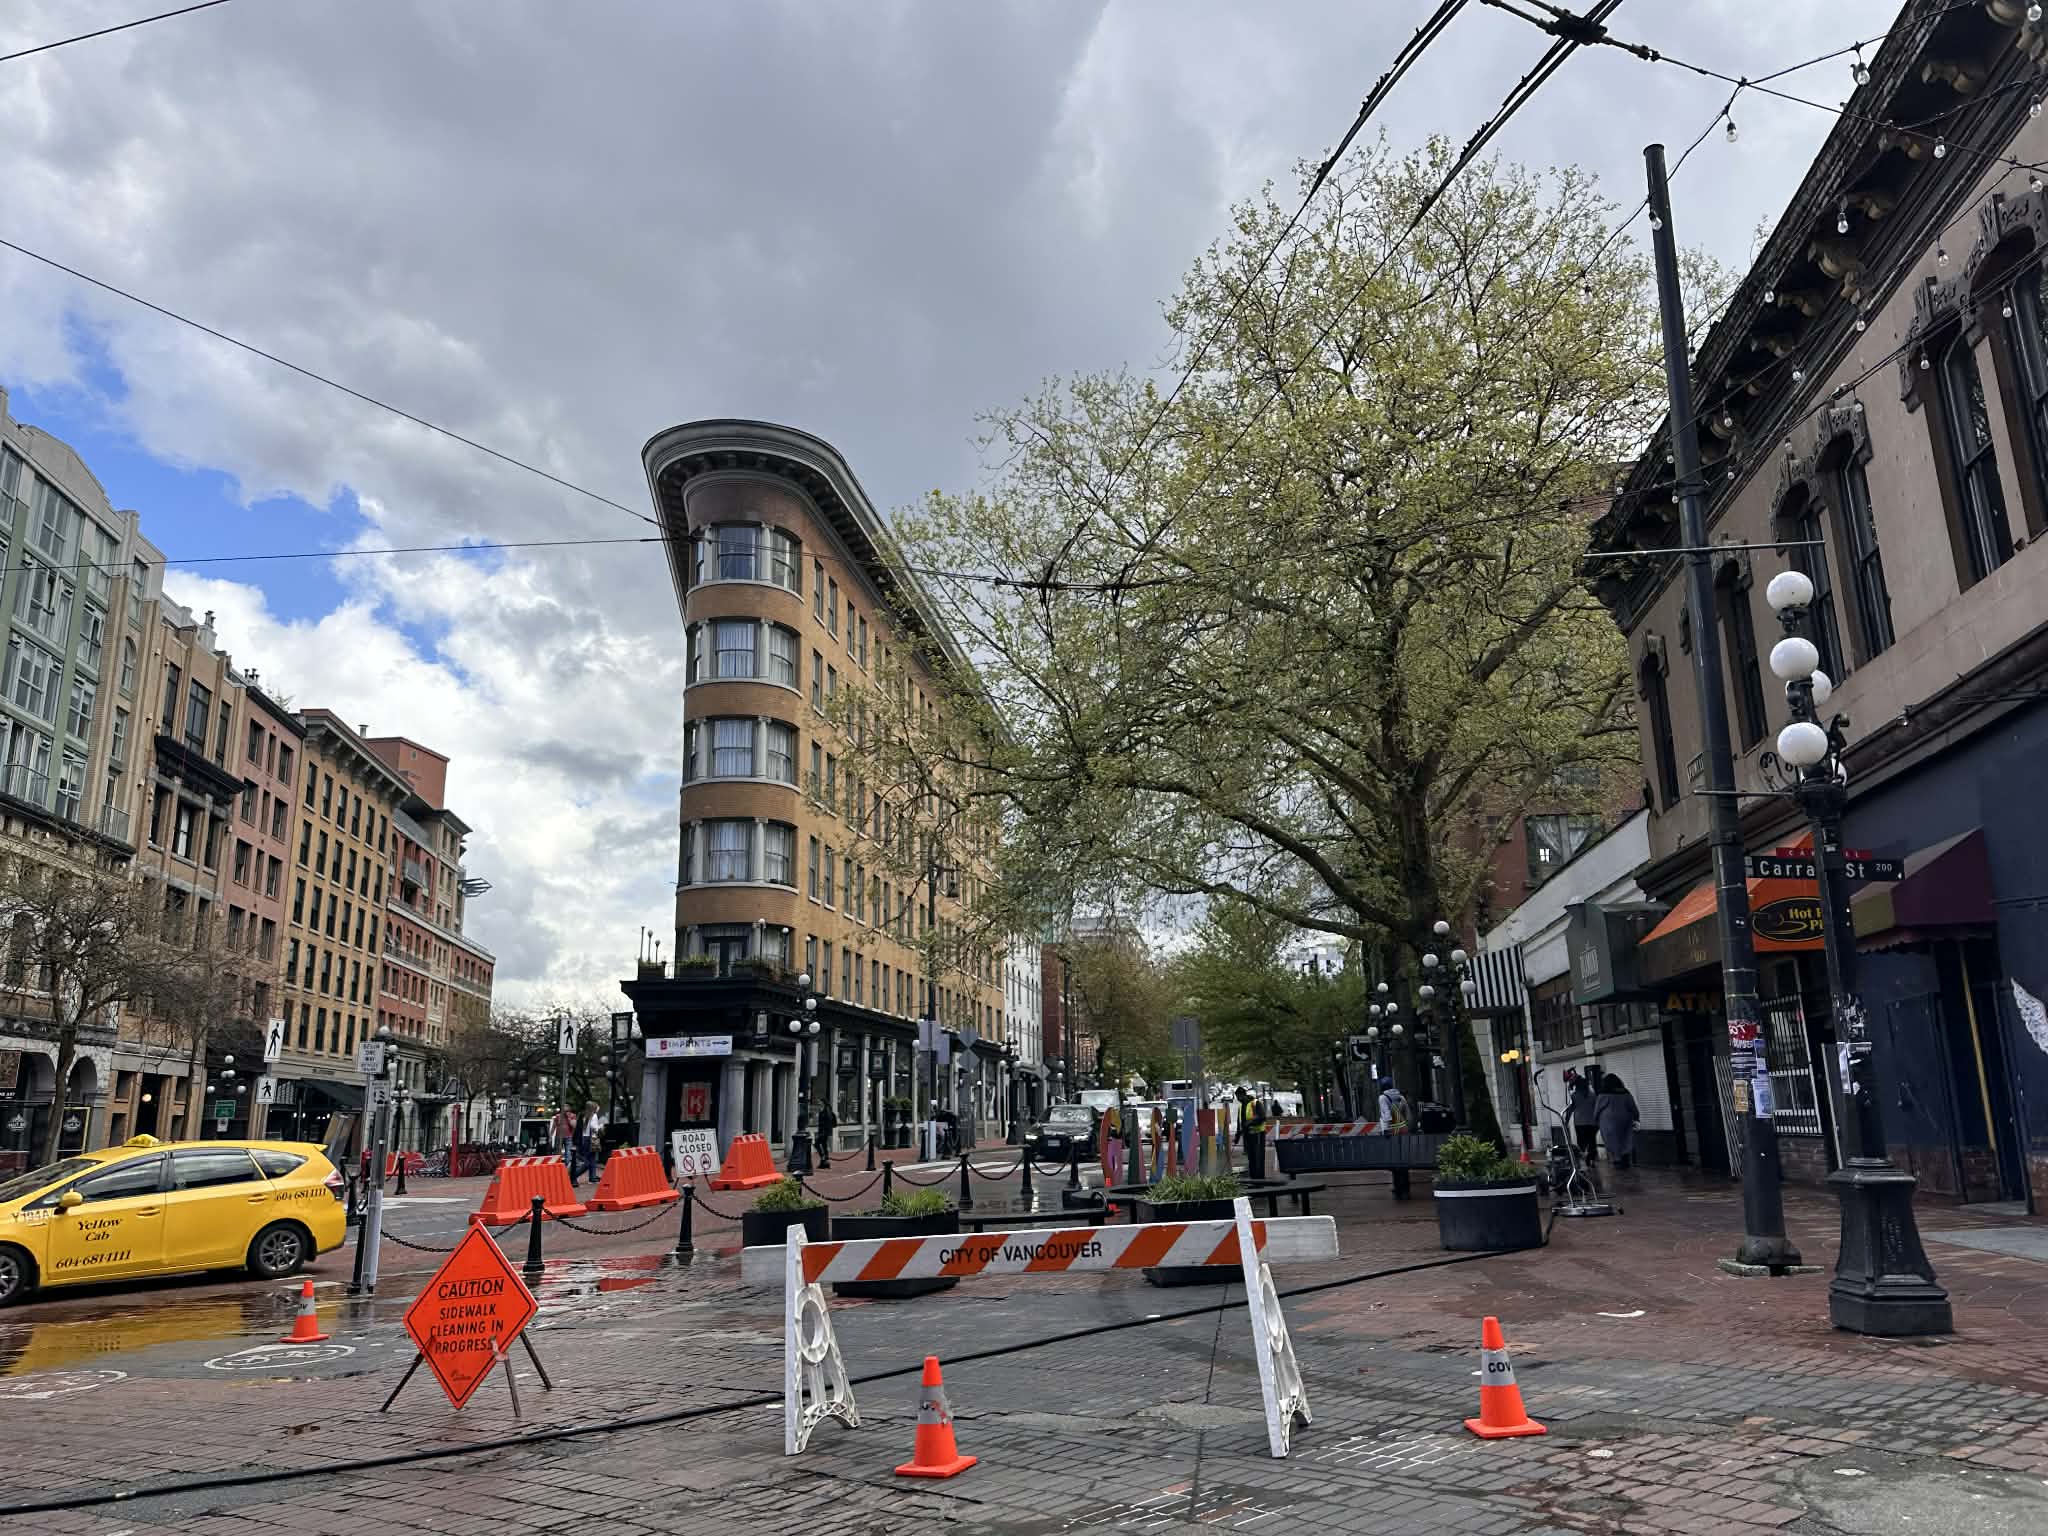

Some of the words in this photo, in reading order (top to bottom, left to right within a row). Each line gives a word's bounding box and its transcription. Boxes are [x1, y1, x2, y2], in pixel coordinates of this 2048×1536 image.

[1760, 861, 1817, 877] Carra
[1845, 863, 1865, 878] St
[1875, 863, 1893, 872] 200
[1789, 908, 1813, 919] Hot
[1666, 991, 1723, 1009] ATM
[682, 1133, 706, 1143] ROAD
[679, 1143, 712, 1154] CLOSED
[77, 1217, 122, 1231] Yellow
[85, 1231, 110, 1241] Cab
[939, 1248, 972, 1265] CITY
[978, 1247, 999, 1262] OF
[1003, 1241, 1102, 1261] VANCOUVER
[438, 1278, 504, 1299] CAUTION
[439, 1303, 496, 1320] SIDEWALK
[430, 1322, 486, 1337] CLEANING
[491, 1320, 504, 1332] IN
[435, 1337, 494, 1354] PROGRESS
[1487, 1361, 1512, 1374] COV
